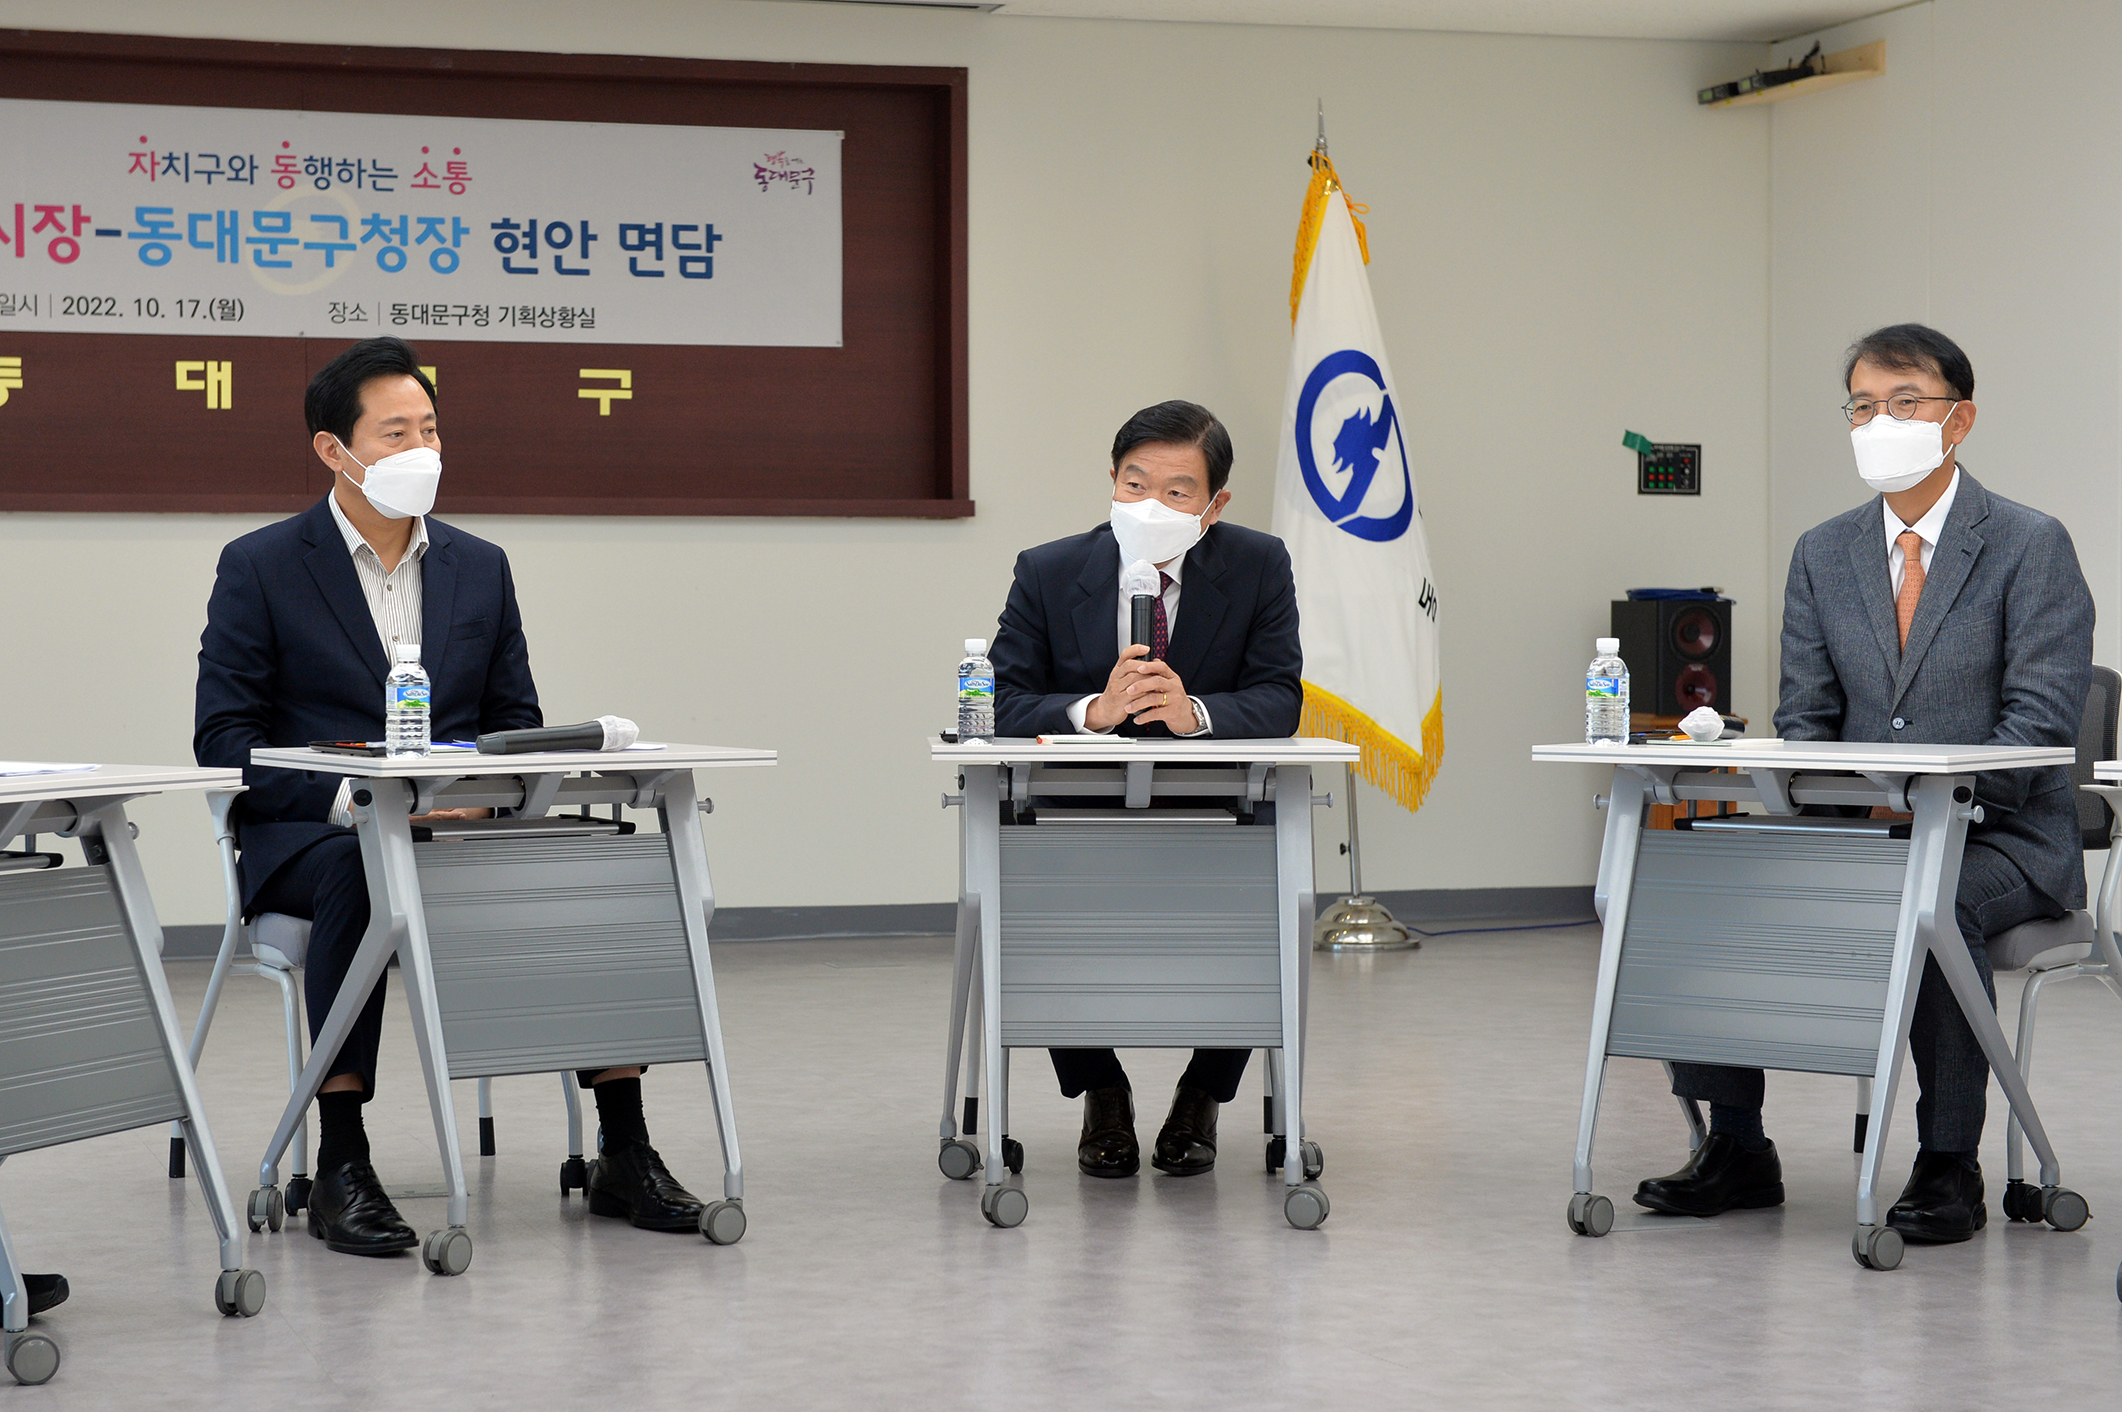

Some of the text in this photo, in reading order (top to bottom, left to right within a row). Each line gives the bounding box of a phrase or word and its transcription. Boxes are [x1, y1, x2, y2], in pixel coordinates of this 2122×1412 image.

[128, 149, 473, 196] 자치구와 동행하는 소통
[490, 217, 599, 277] 현안
[618, 221, 724, 281] 면담
[62, 296, 125, 319] 2022.
[134, 298, 167, 320] 10.
[328, 302, 596, 330] 장소 동대문구청 기획상황실
